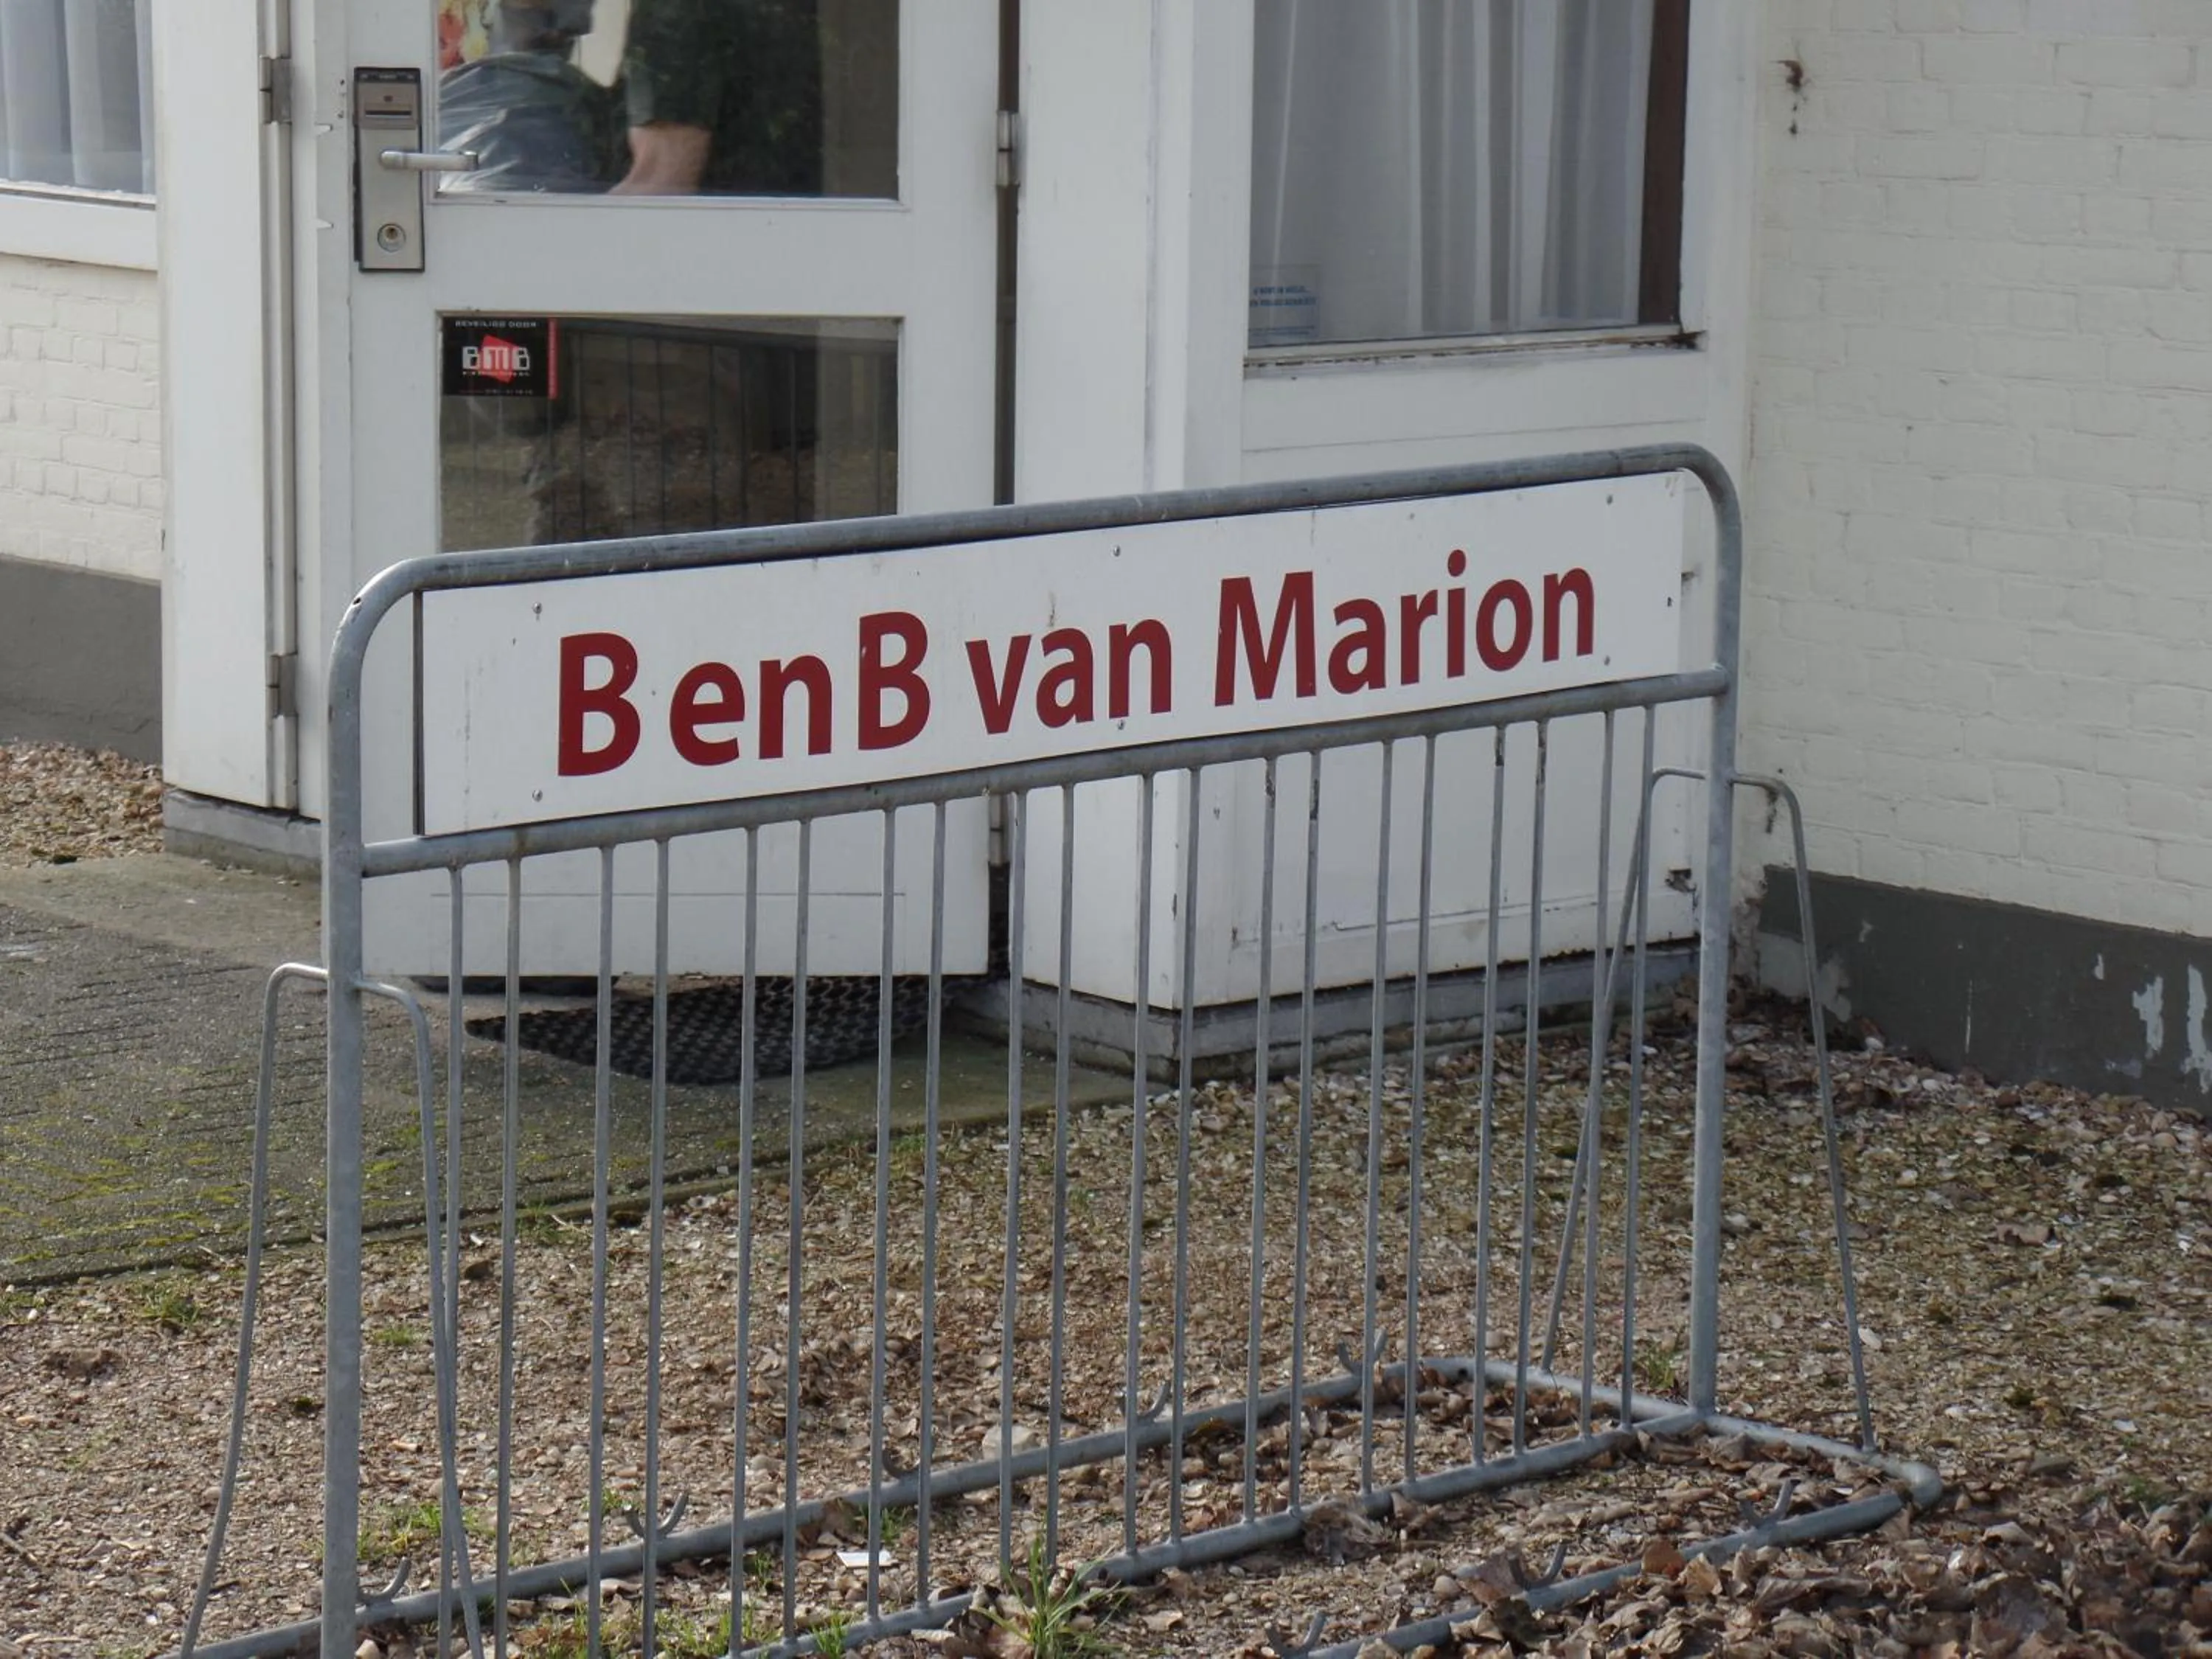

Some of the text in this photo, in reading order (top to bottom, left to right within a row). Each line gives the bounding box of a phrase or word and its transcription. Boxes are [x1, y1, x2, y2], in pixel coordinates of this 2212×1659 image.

[462, 346, 530, 370] BMB
[965, 619, 1171, 734] van
[1215, 551, 1593, 706] Marion
